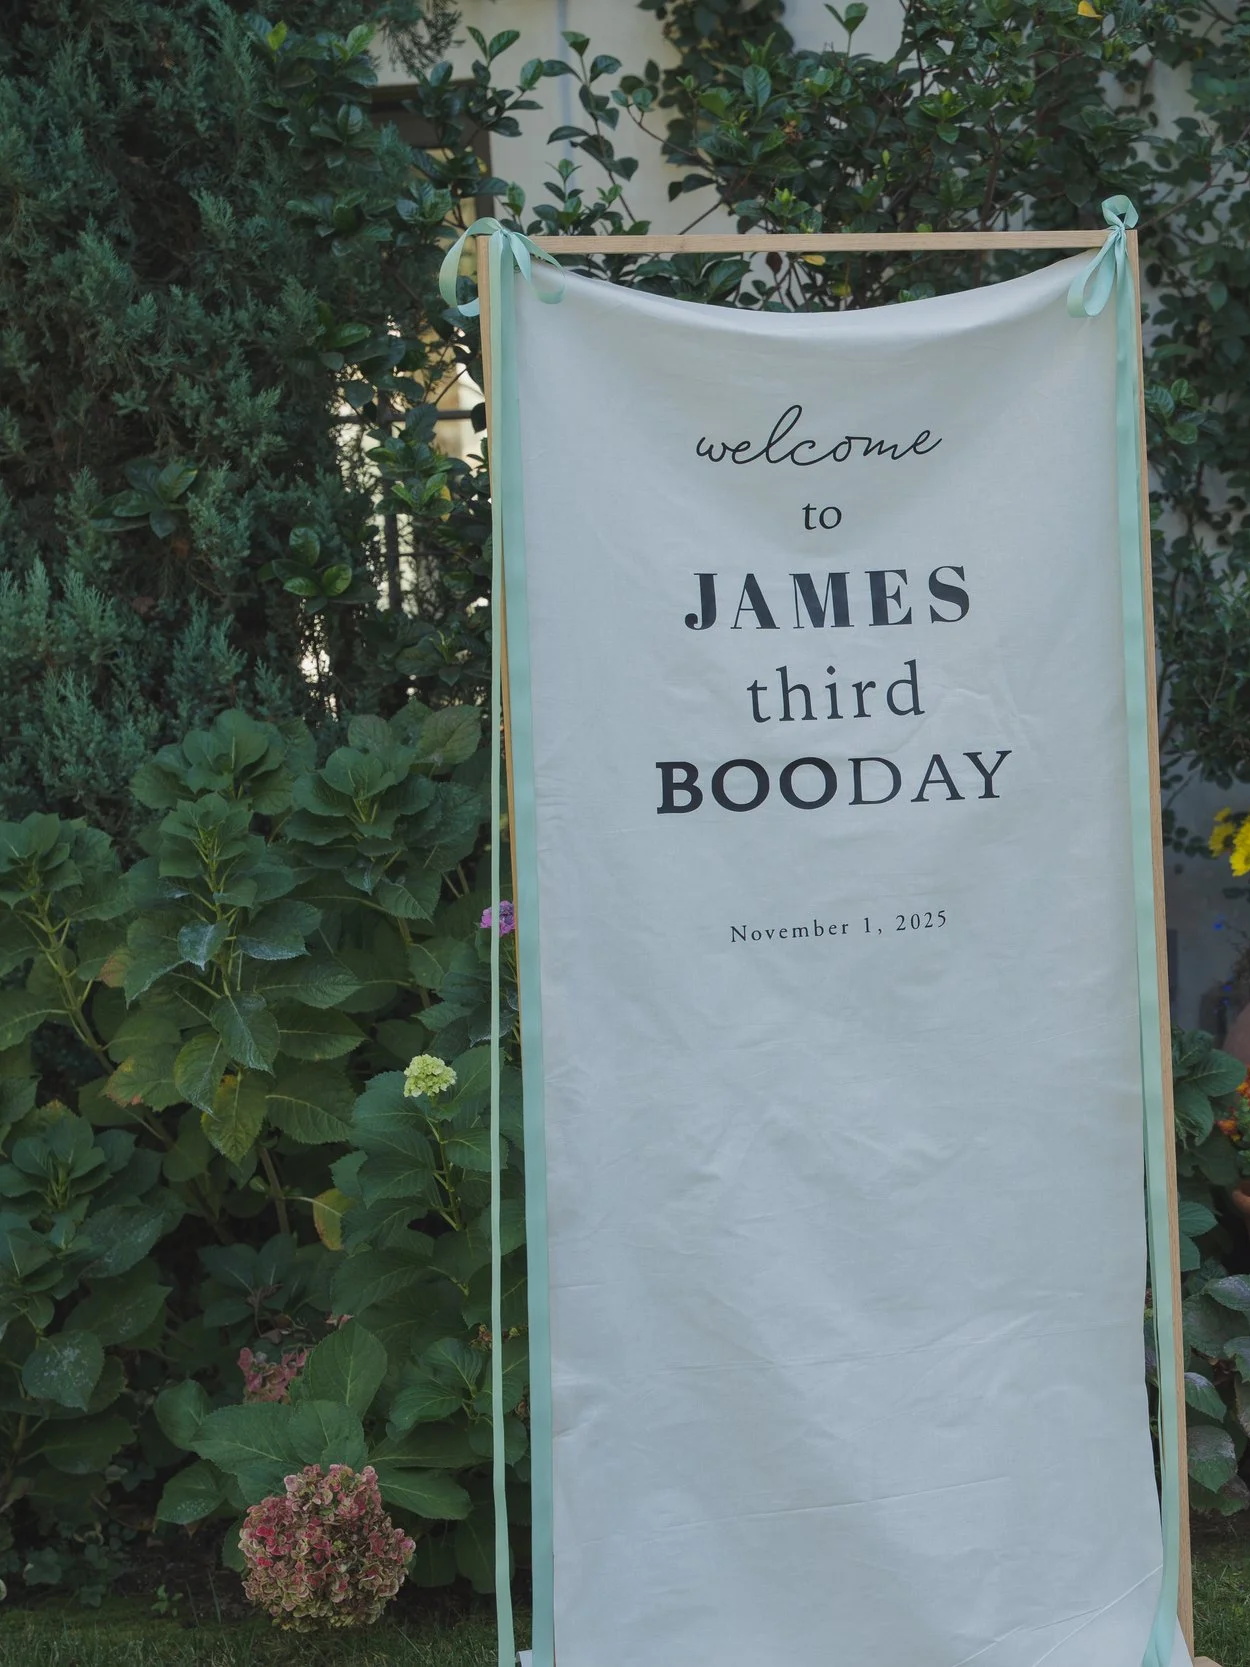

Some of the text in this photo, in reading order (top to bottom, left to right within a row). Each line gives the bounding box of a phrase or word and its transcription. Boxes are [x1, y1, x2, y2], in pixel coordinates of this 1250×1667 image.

[696, 404, 943, 467] welcome
[801, 502, 843, 531] to
[684, 565, 970, 631] JAMES
[746, 659, 926, 723] third
[655, 749, 1013, 815] BOODAY
[730, 909, 947, 943] November 1, 2025
